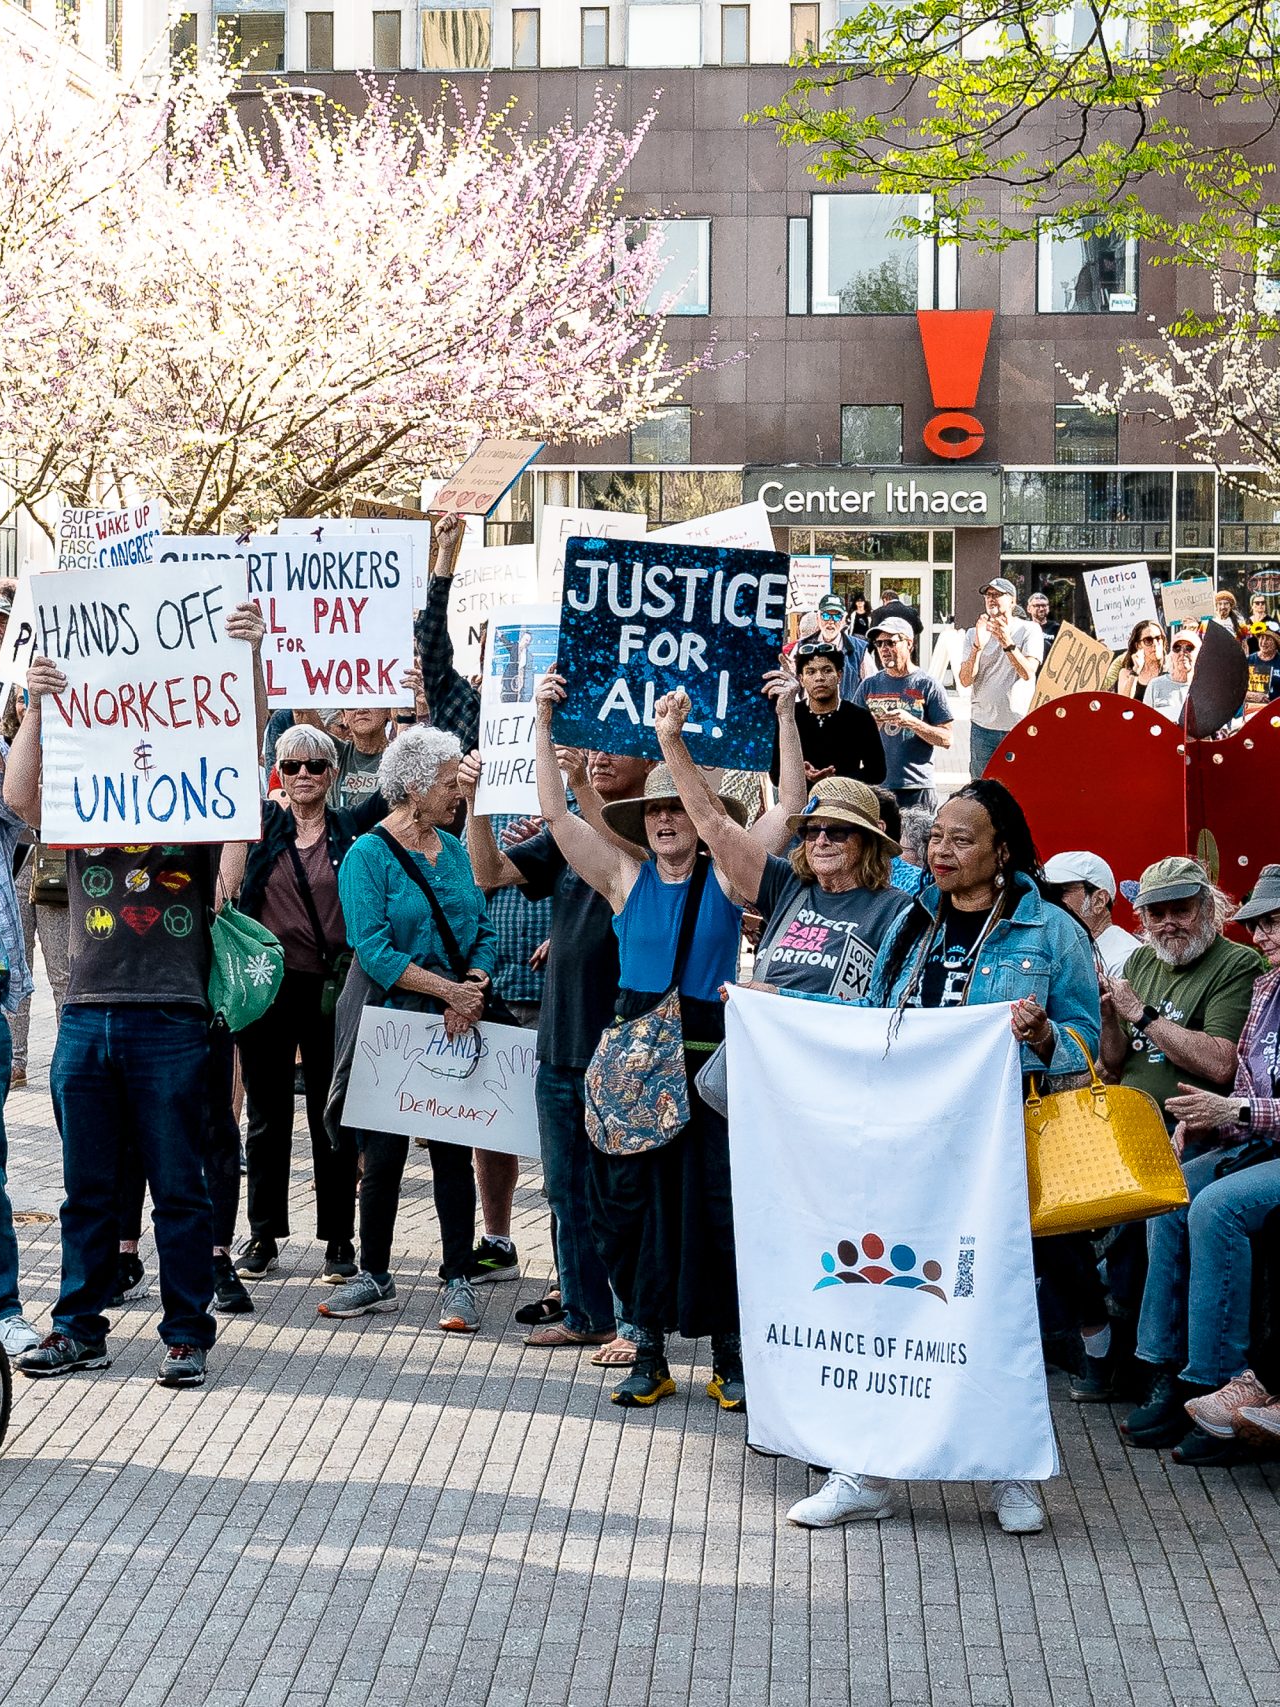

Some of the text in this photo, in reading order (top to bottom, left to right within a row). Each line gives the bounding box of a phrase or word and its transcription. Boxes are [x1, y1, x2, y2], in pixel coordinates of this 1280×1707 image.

[757, 480, 988, 514] Center Ithaca
[95, 505, 150, 541] WAKE UP
[285, 551, 401, 592] WORKERS
[453, 565, 528, 589] GENERAL
[1090, 571, 1137, 588] America
[566, 559, 789, 630] JUSTICE
[1096, 594, 1146, 612] Living Wage
[1103, 584, 1125, 595] needs
[38, 600, 140, 660] HANDS
[156, 585, 223, 650] OFF
[314, 597, 369, 634] PAY
[277, 638, 306, 652] FOR
[619, 625, 709, 673] FOR
[1047, 630, 1110, 692] CHAOS
[302, 658, 400, 695] WORK
[52, 672, 241, 732] WORKERS
[74, 757, 239, 825] UNIONS
[787, 921, 829, 942] SAFE
[797, 908, 859, 934] ROTECT
[756, 947, 838, 970] AORTION
[779, 935, 827, 952] EGAL
[426, 1028, 489, 1059] HANDS
[431, 1066, 469, 1082] OFF
[399, 1091, 498, 1126] DEMOCRACY
[766, 1323, 968, 1365] ALLIANCE OF FAMILIES
[821, 1366, 933, 1399] FOR JUSTICE
